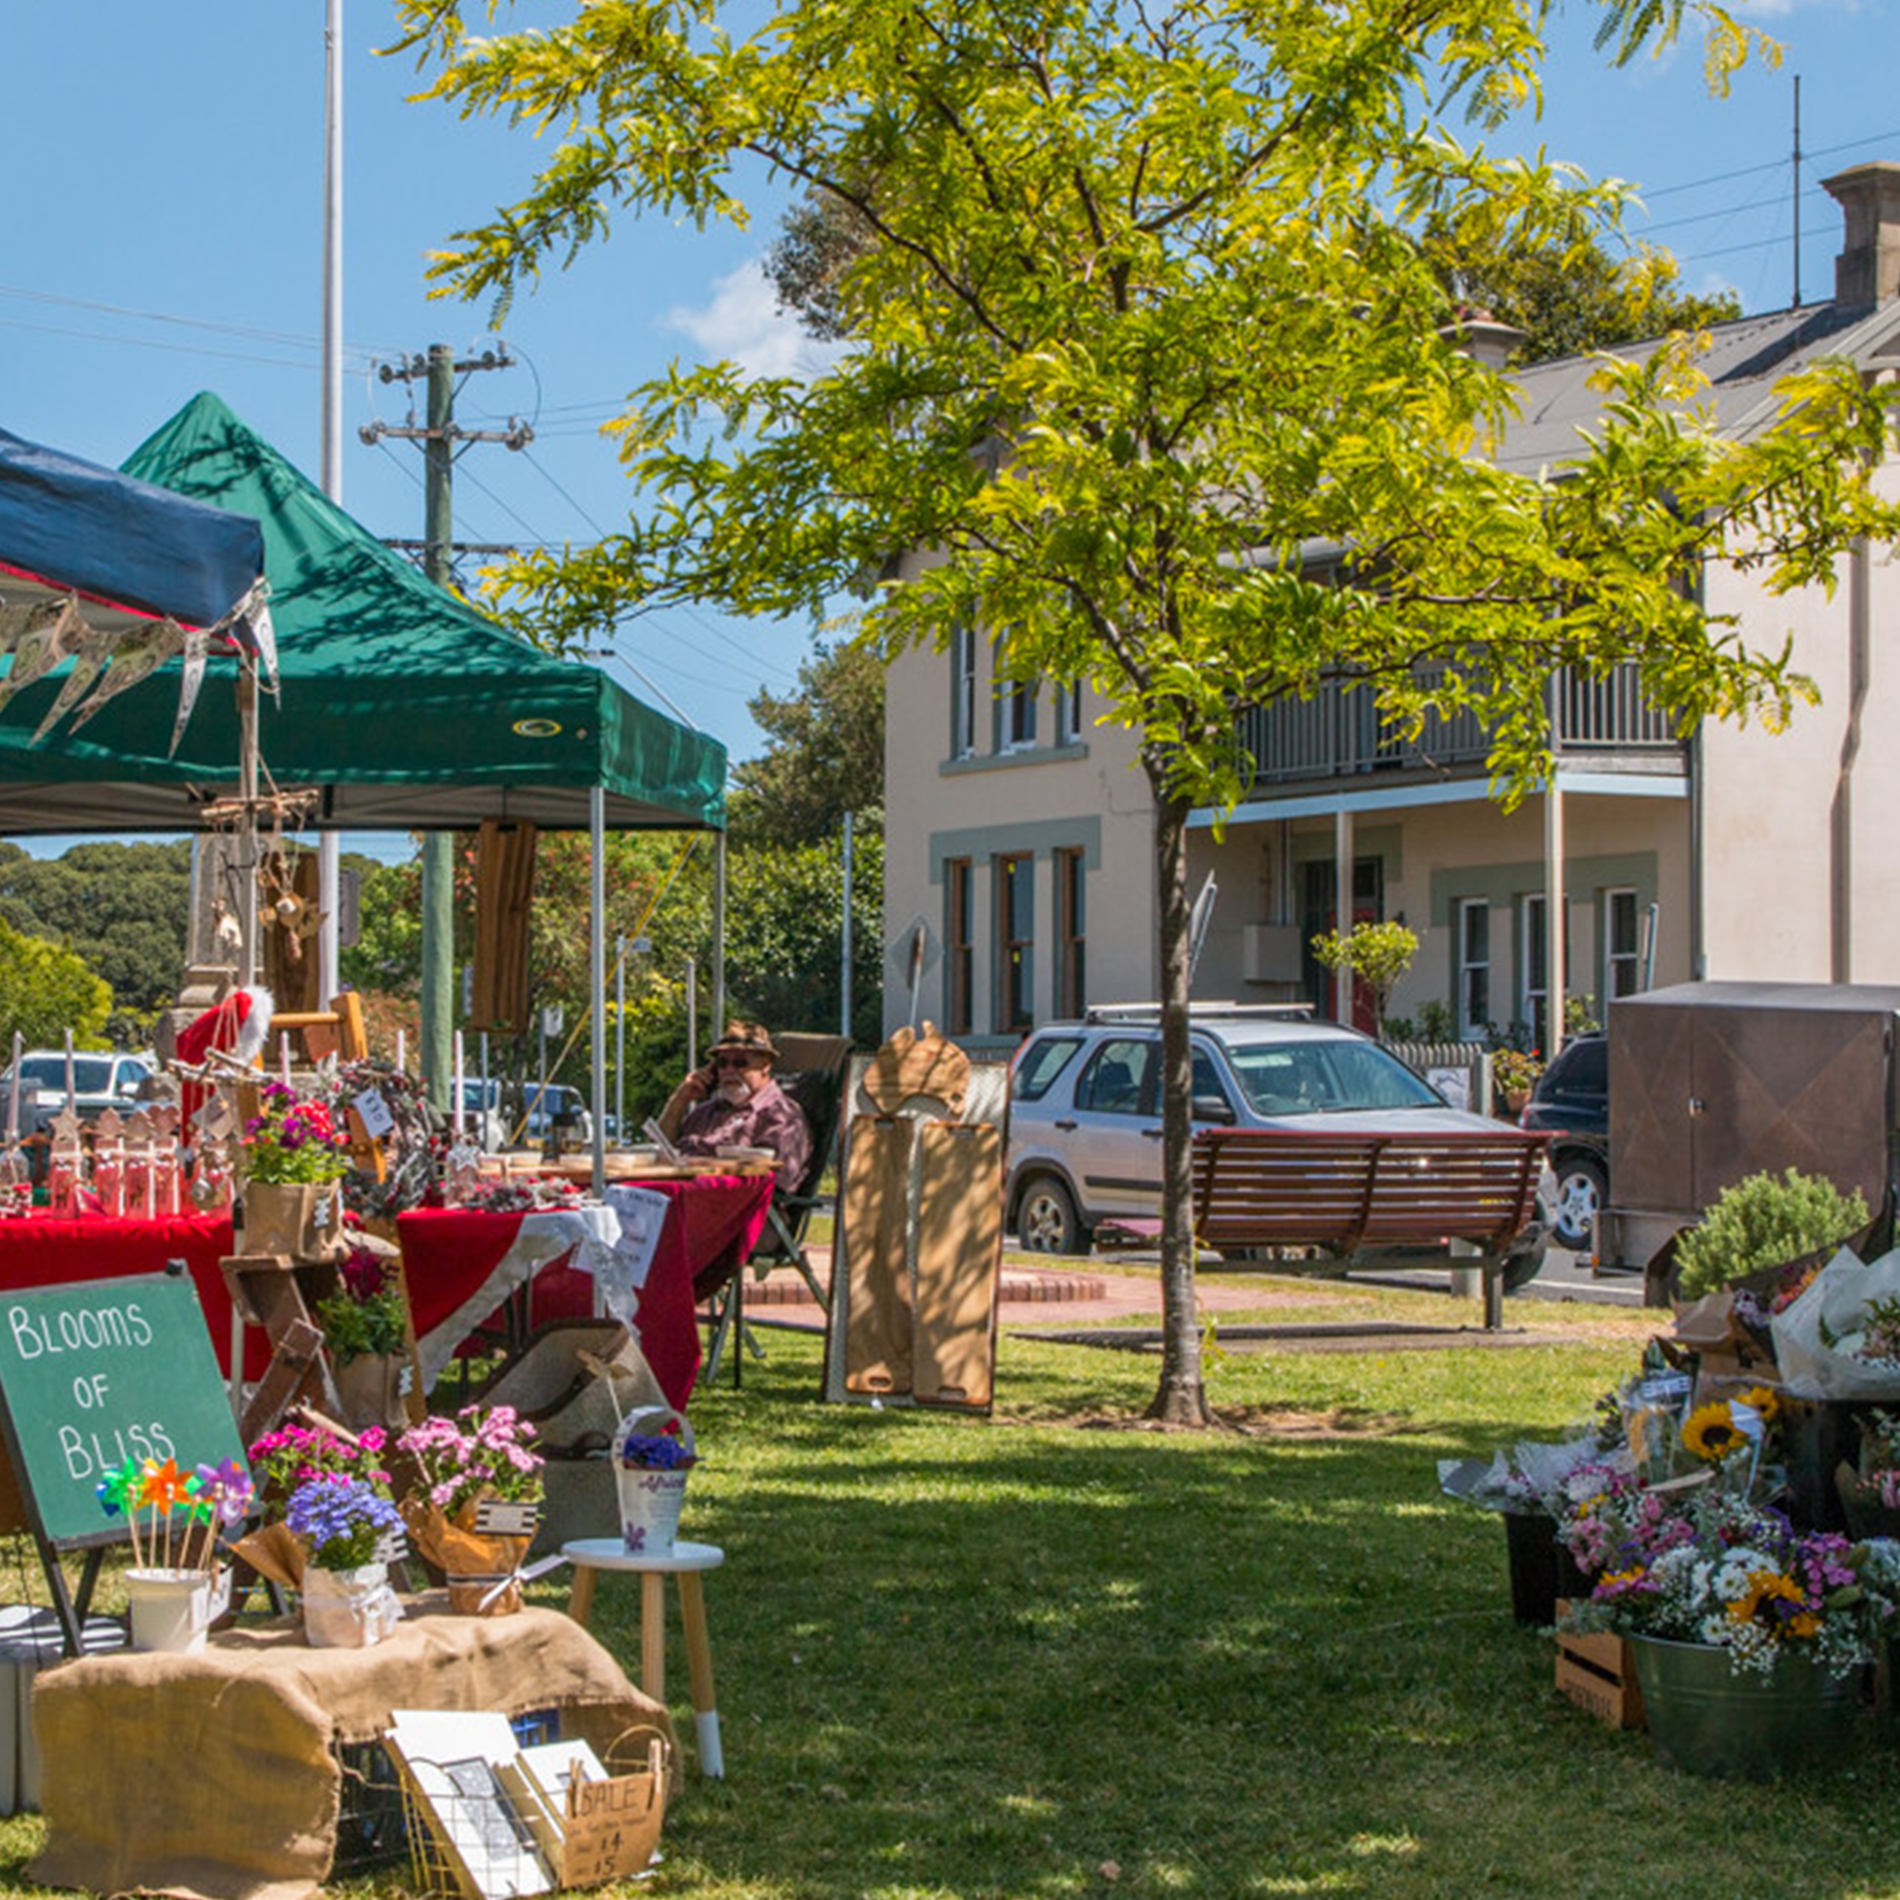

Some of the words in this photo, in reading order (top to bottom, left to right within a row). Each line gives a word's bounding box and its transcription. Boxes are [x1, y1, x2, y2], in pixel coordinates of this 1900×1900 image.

[73, 1374, 109, 1408] OF
[58, 1422, 176, 1479] BLISS
[581, 1782, 638, 1817] SALE
